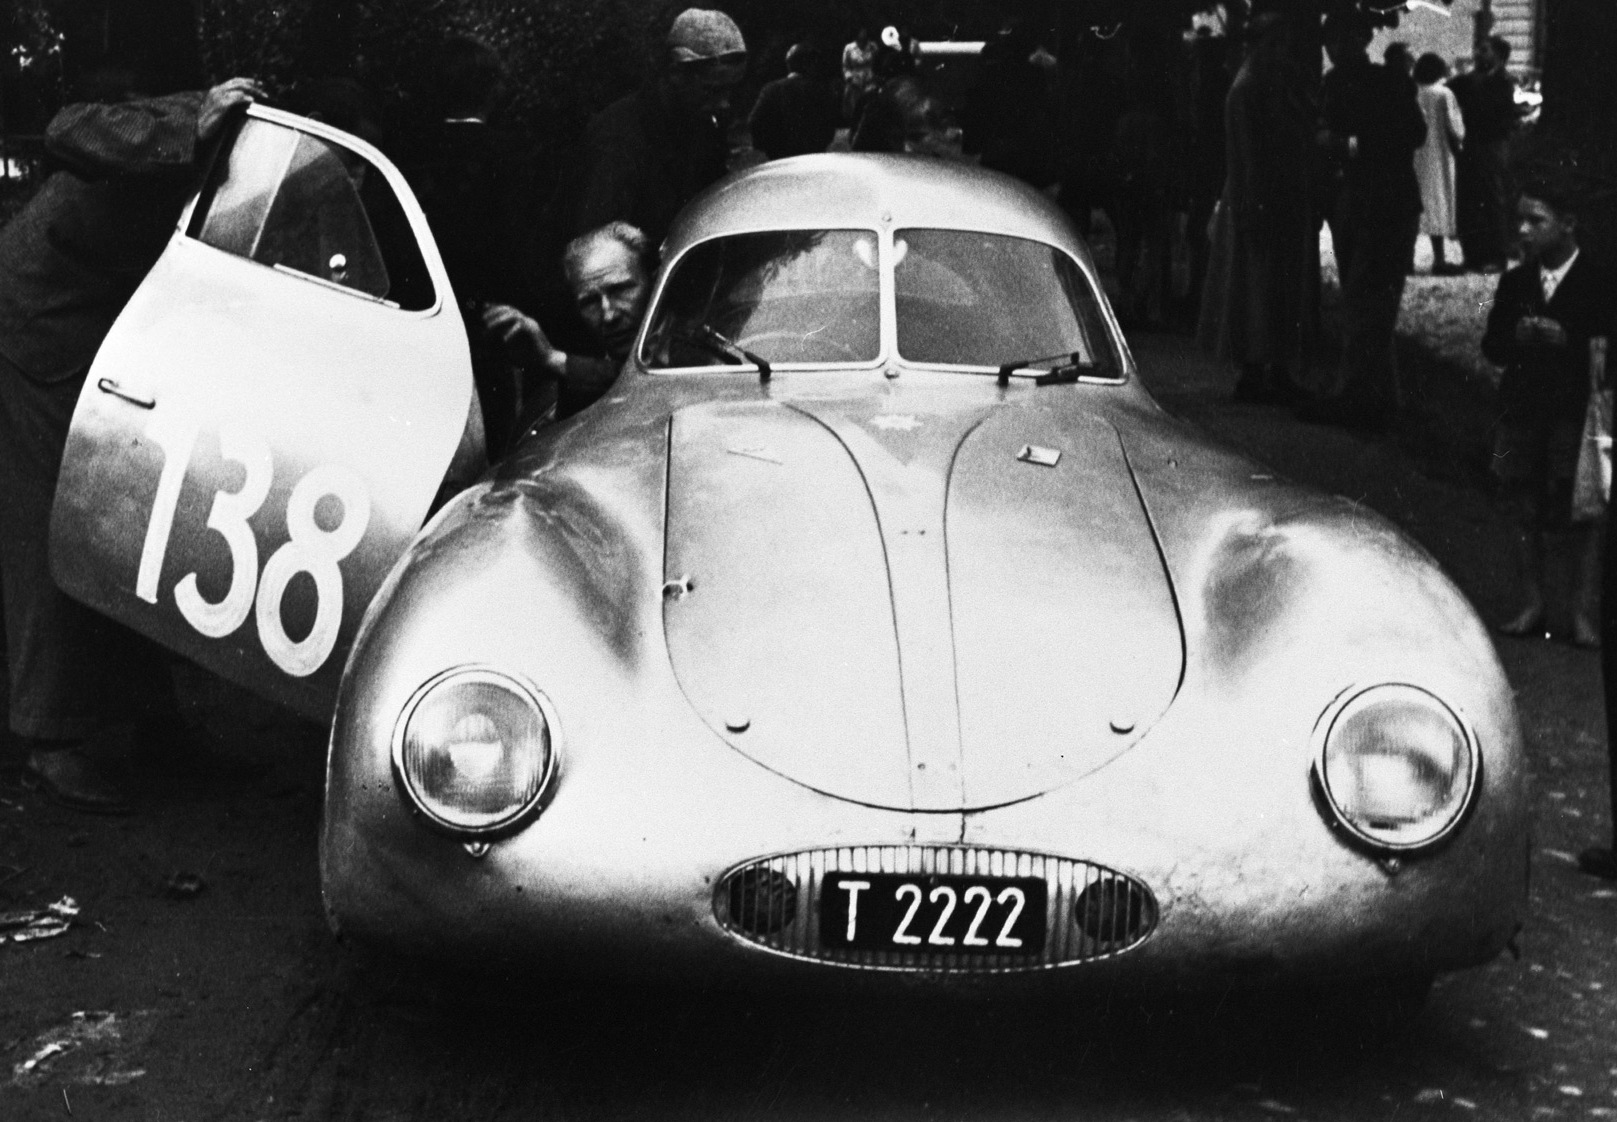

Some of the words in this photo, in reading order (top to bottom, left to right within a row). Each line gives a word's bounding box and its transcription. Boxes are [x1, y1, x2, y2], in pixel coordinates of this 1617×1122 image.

[136, 408, 372, 677] 138
[838, 881, 870, 941] T
[892, 884, 1025, 947] 2222
